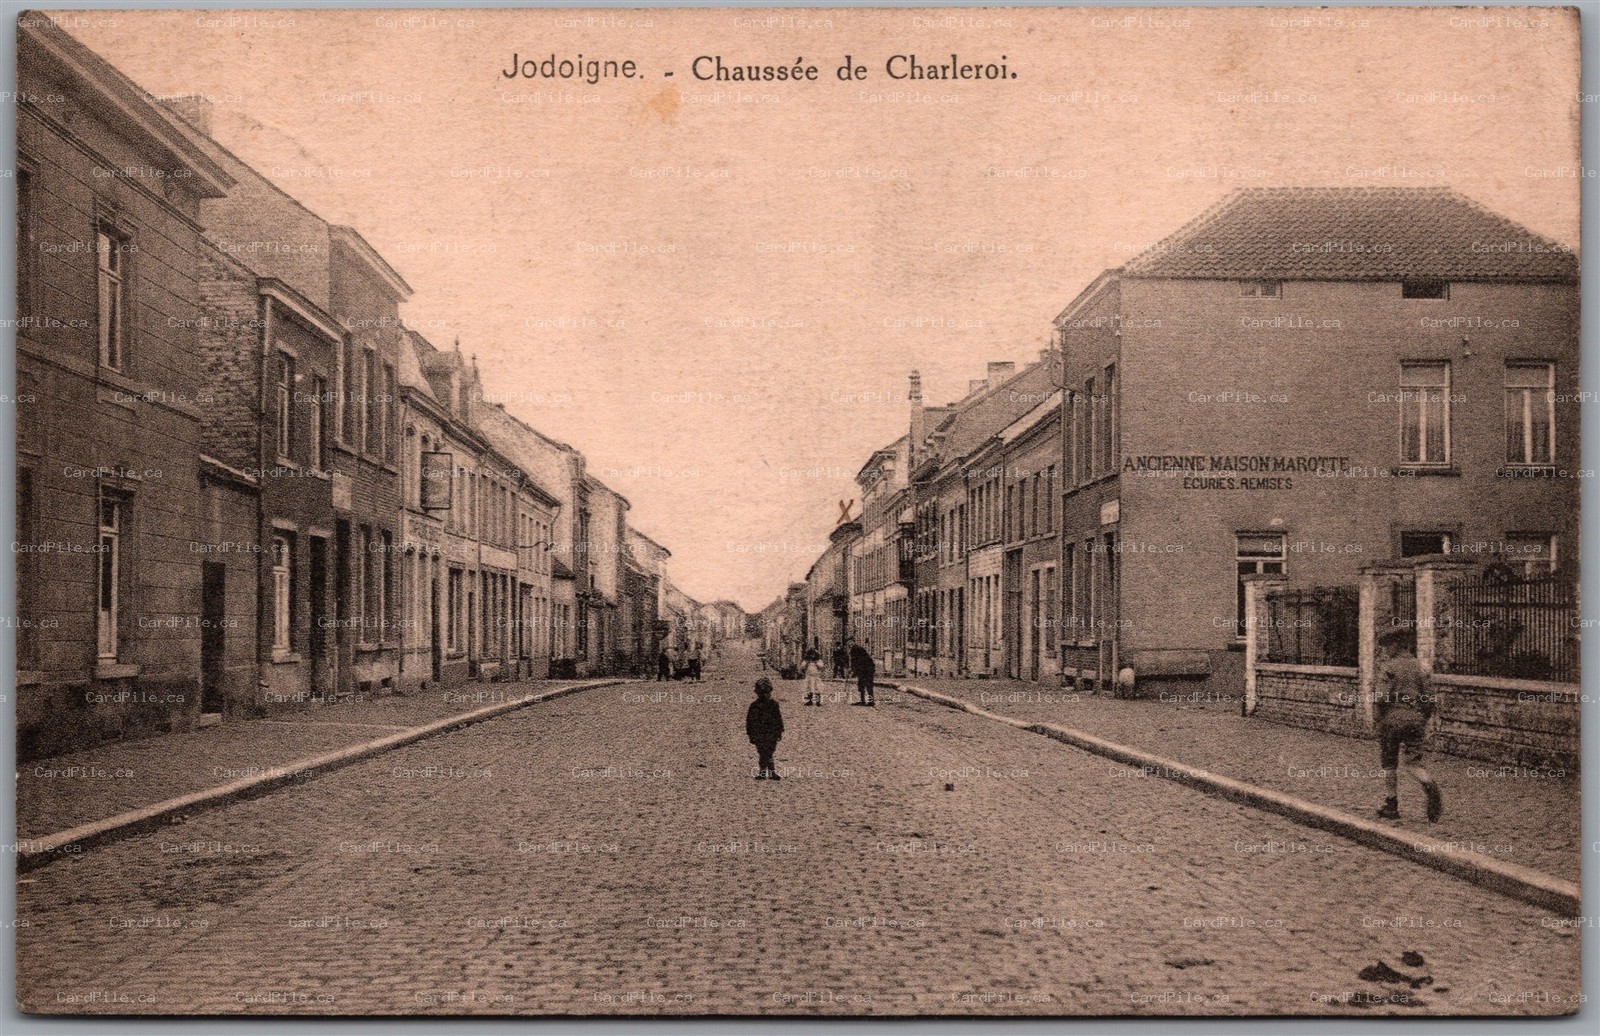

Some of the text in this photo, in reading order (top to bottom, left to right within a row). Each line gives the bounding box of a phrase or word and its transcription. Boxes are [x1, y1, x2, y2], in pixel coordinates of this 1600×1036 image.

[1123, 455, 1350, 472] ANCIENNE MAISON MAROTTE
